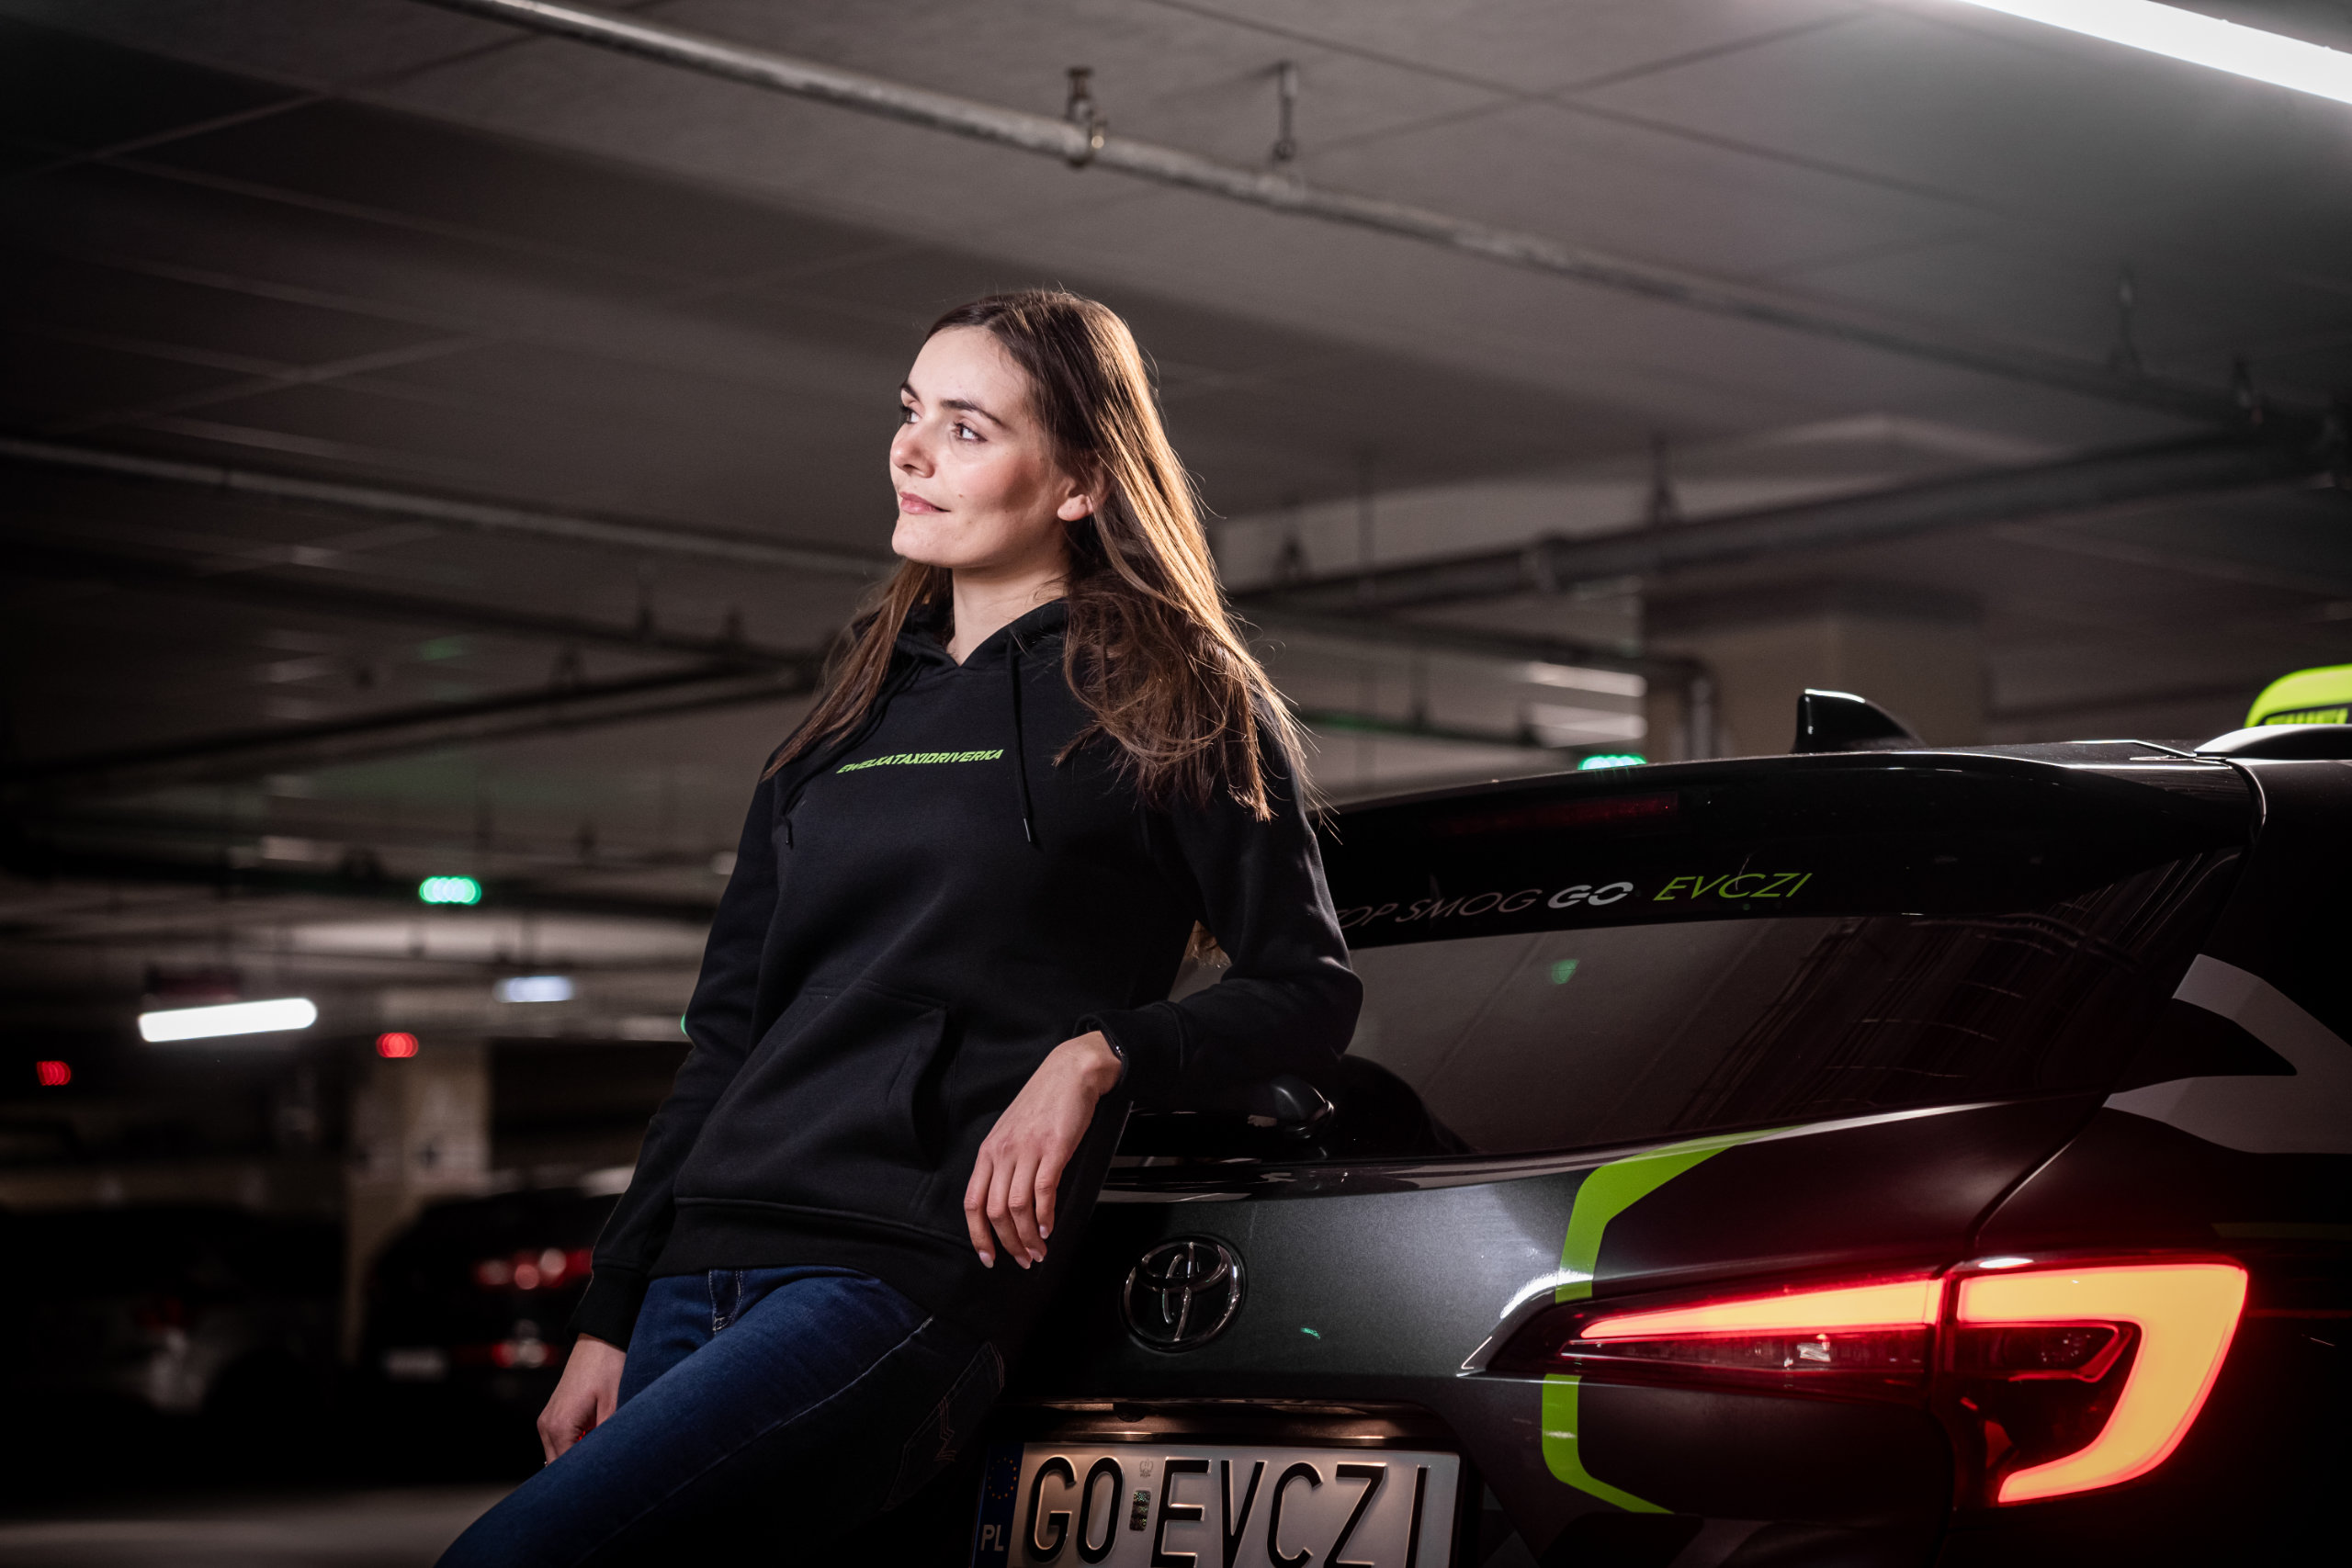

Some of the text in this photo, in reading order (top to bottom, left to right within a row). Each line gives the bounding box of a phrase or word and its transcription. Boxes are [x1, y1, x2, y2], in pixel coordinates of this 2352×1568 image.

[1395, 887, 1544, 924] SMOG
[1546, 881, 1634, 909] GO
[1652, 872, 1815, 902] EVCZI
[979, 1524, 1004, 1551] PL
[1150, 1456, 1431, 1568] EVCZI
